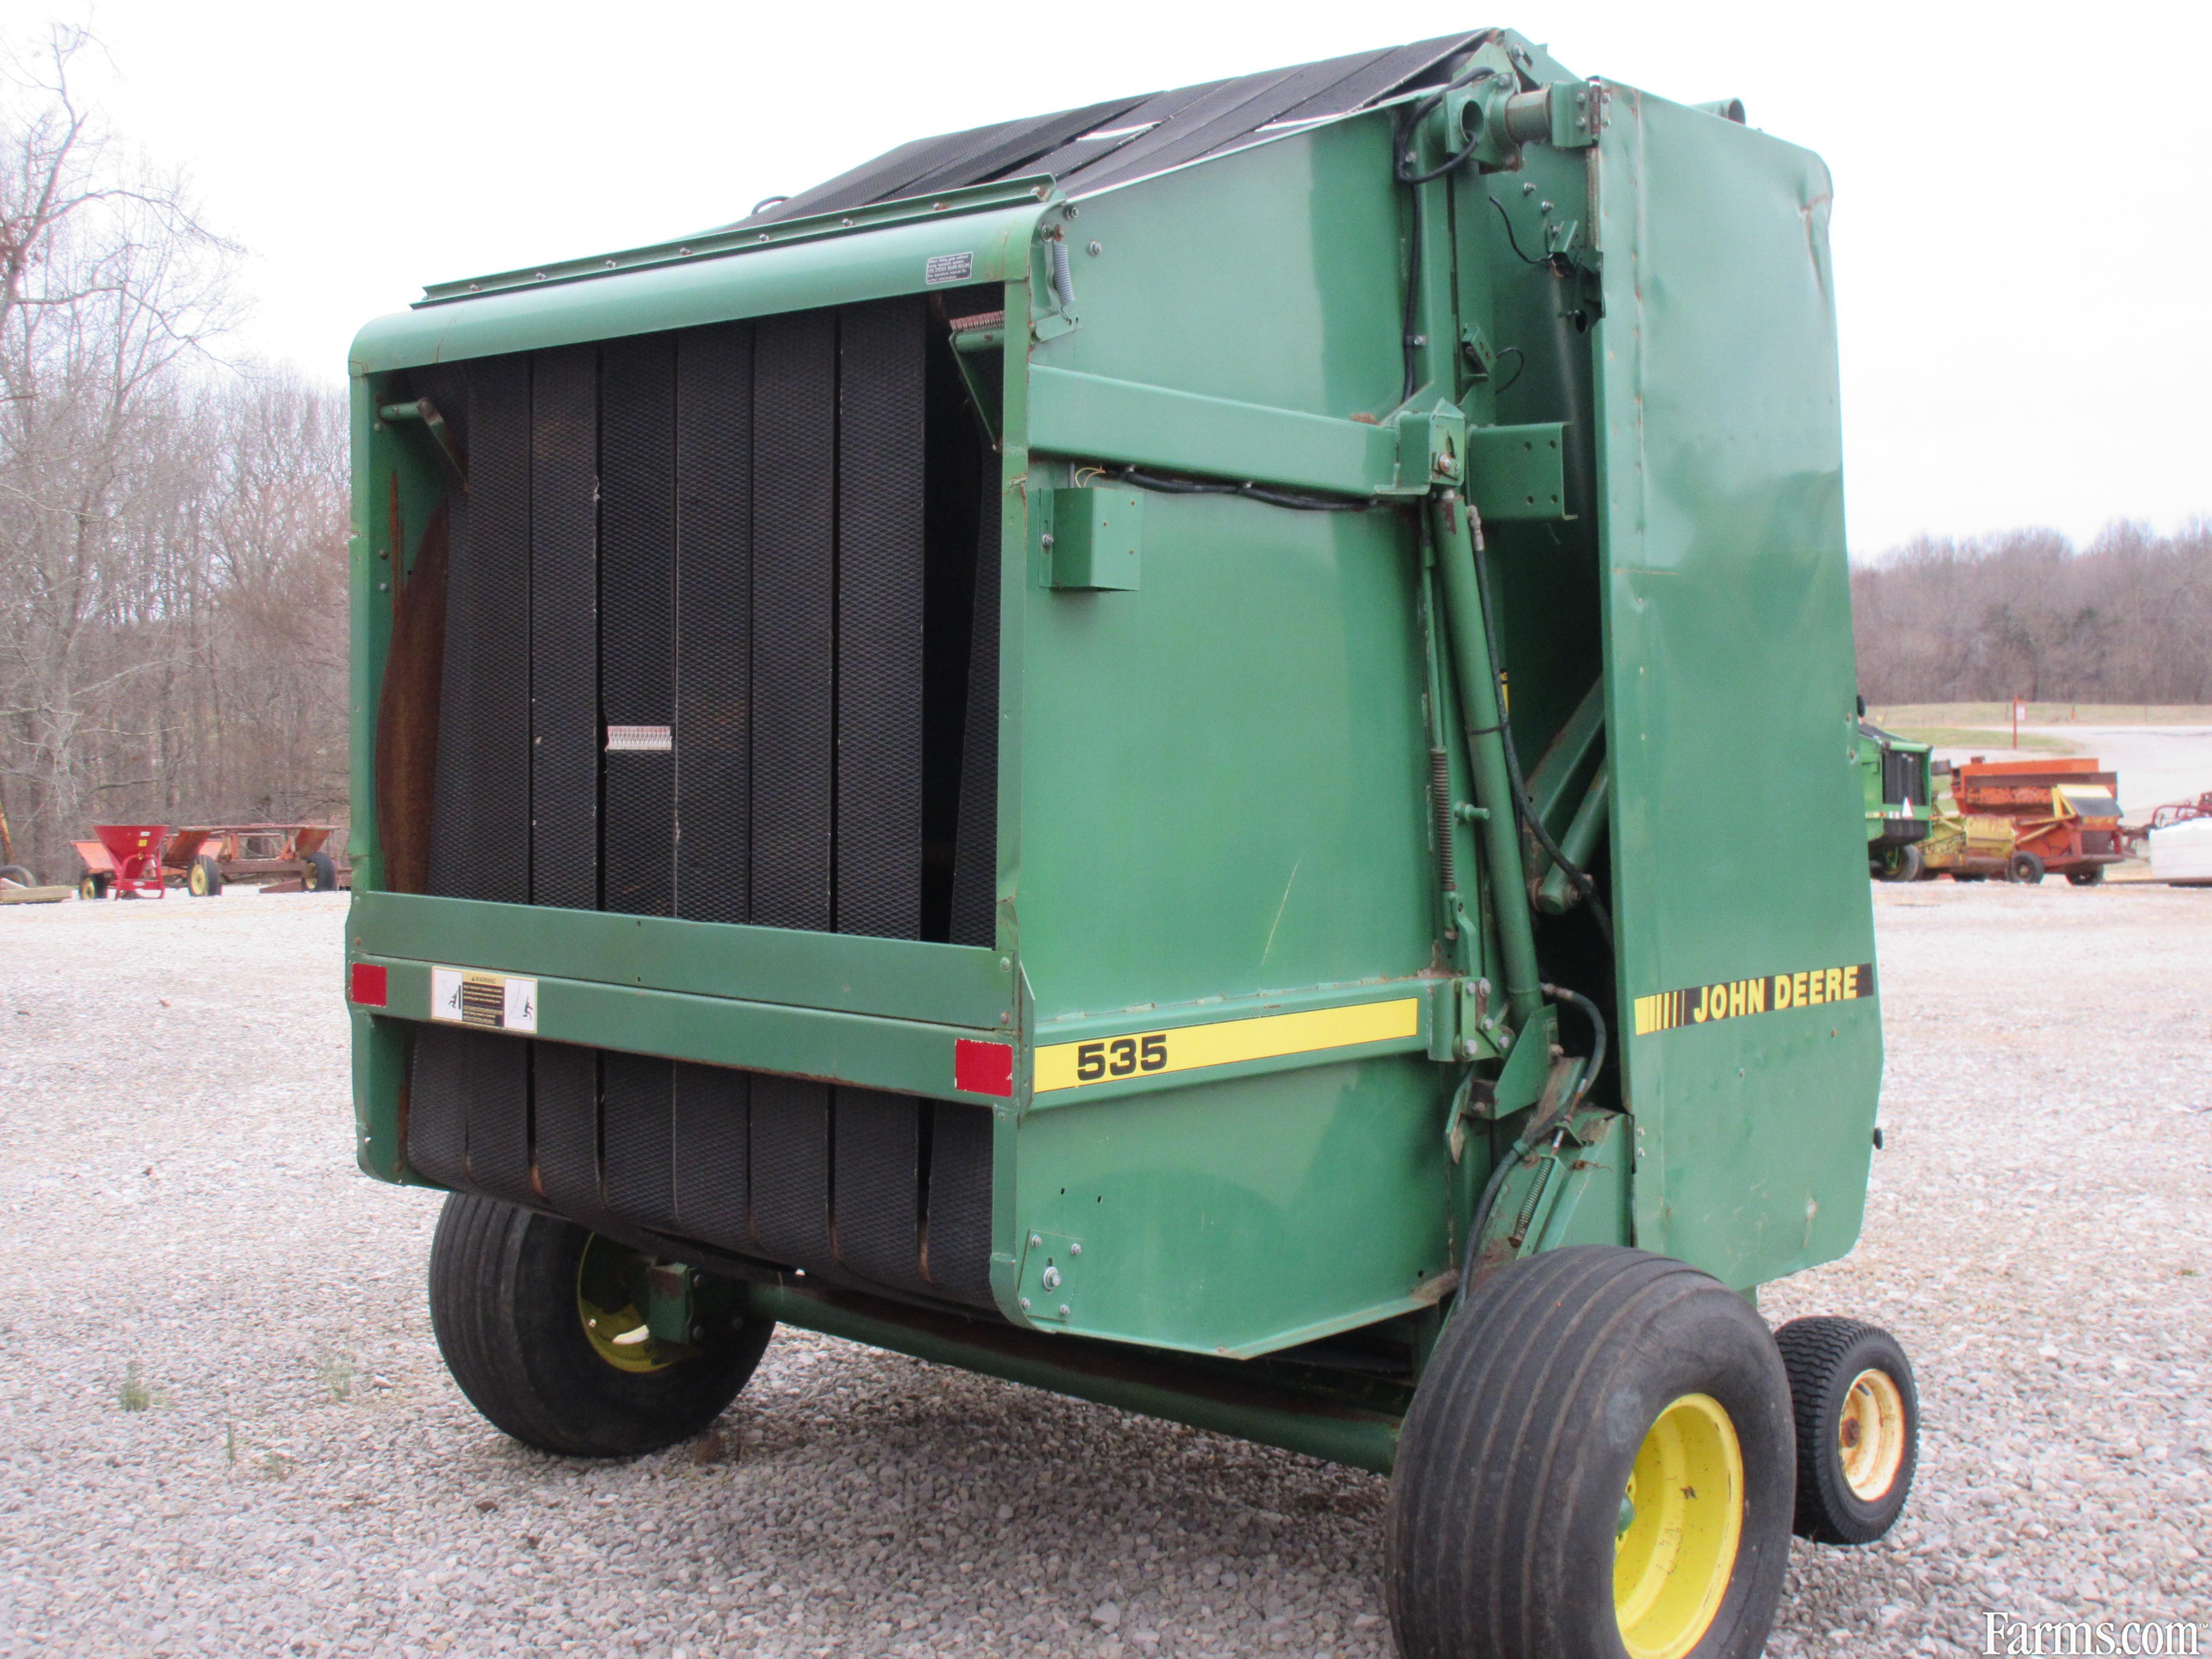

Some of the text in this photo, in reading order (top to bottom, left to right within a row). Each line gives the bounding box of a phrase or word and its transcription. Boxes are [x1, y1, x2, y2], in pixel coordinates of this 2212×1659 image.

[1694, 965, 1859, 1023] JOHN DEERE
[1077, 1034, 1167, 1081] 535
